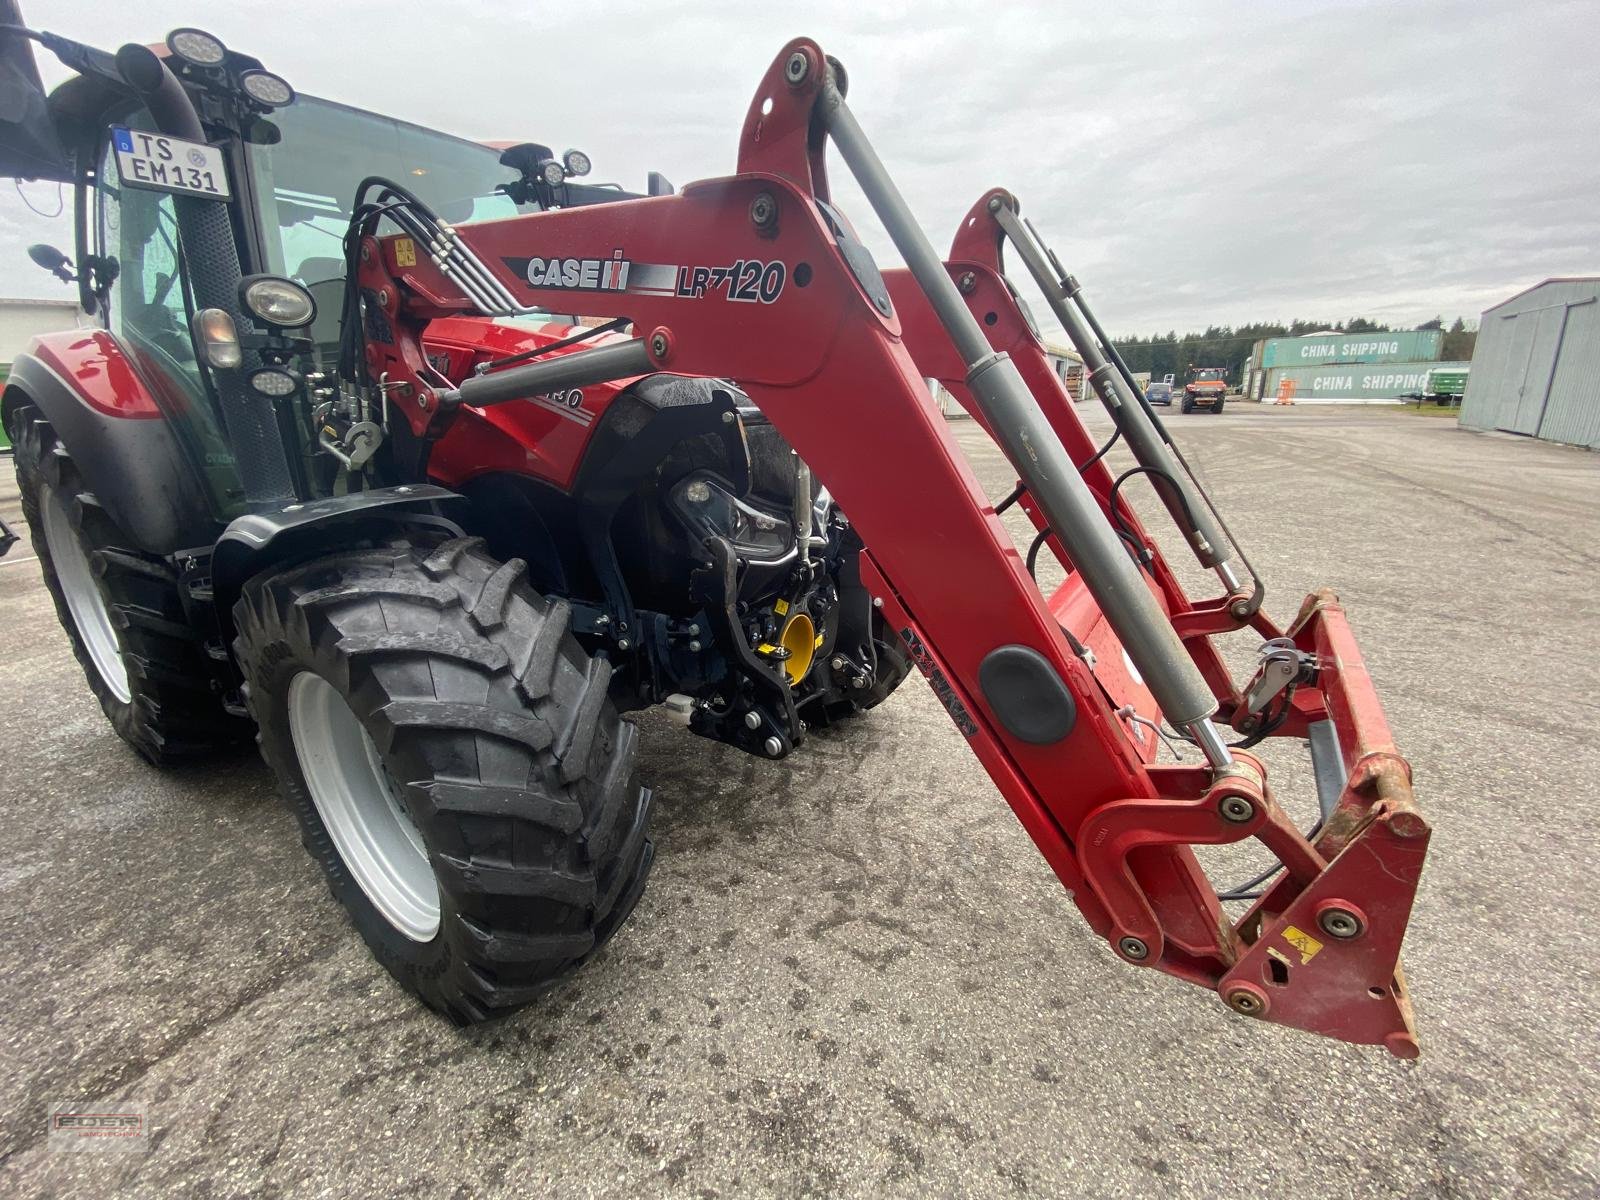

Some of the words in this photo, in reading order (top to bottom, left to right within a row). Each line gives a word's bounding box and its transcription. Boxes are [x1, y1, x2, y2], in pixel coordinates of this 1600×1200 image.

[137, 134, 173, 161] TS
[1301, 345, 1336, 358] CHINA
[1342, 341, 1399, 357] SHIPPING
[1313, 376, 1353, 391] CHINA
[1362, 374, 1427, 389] SHIPPING
